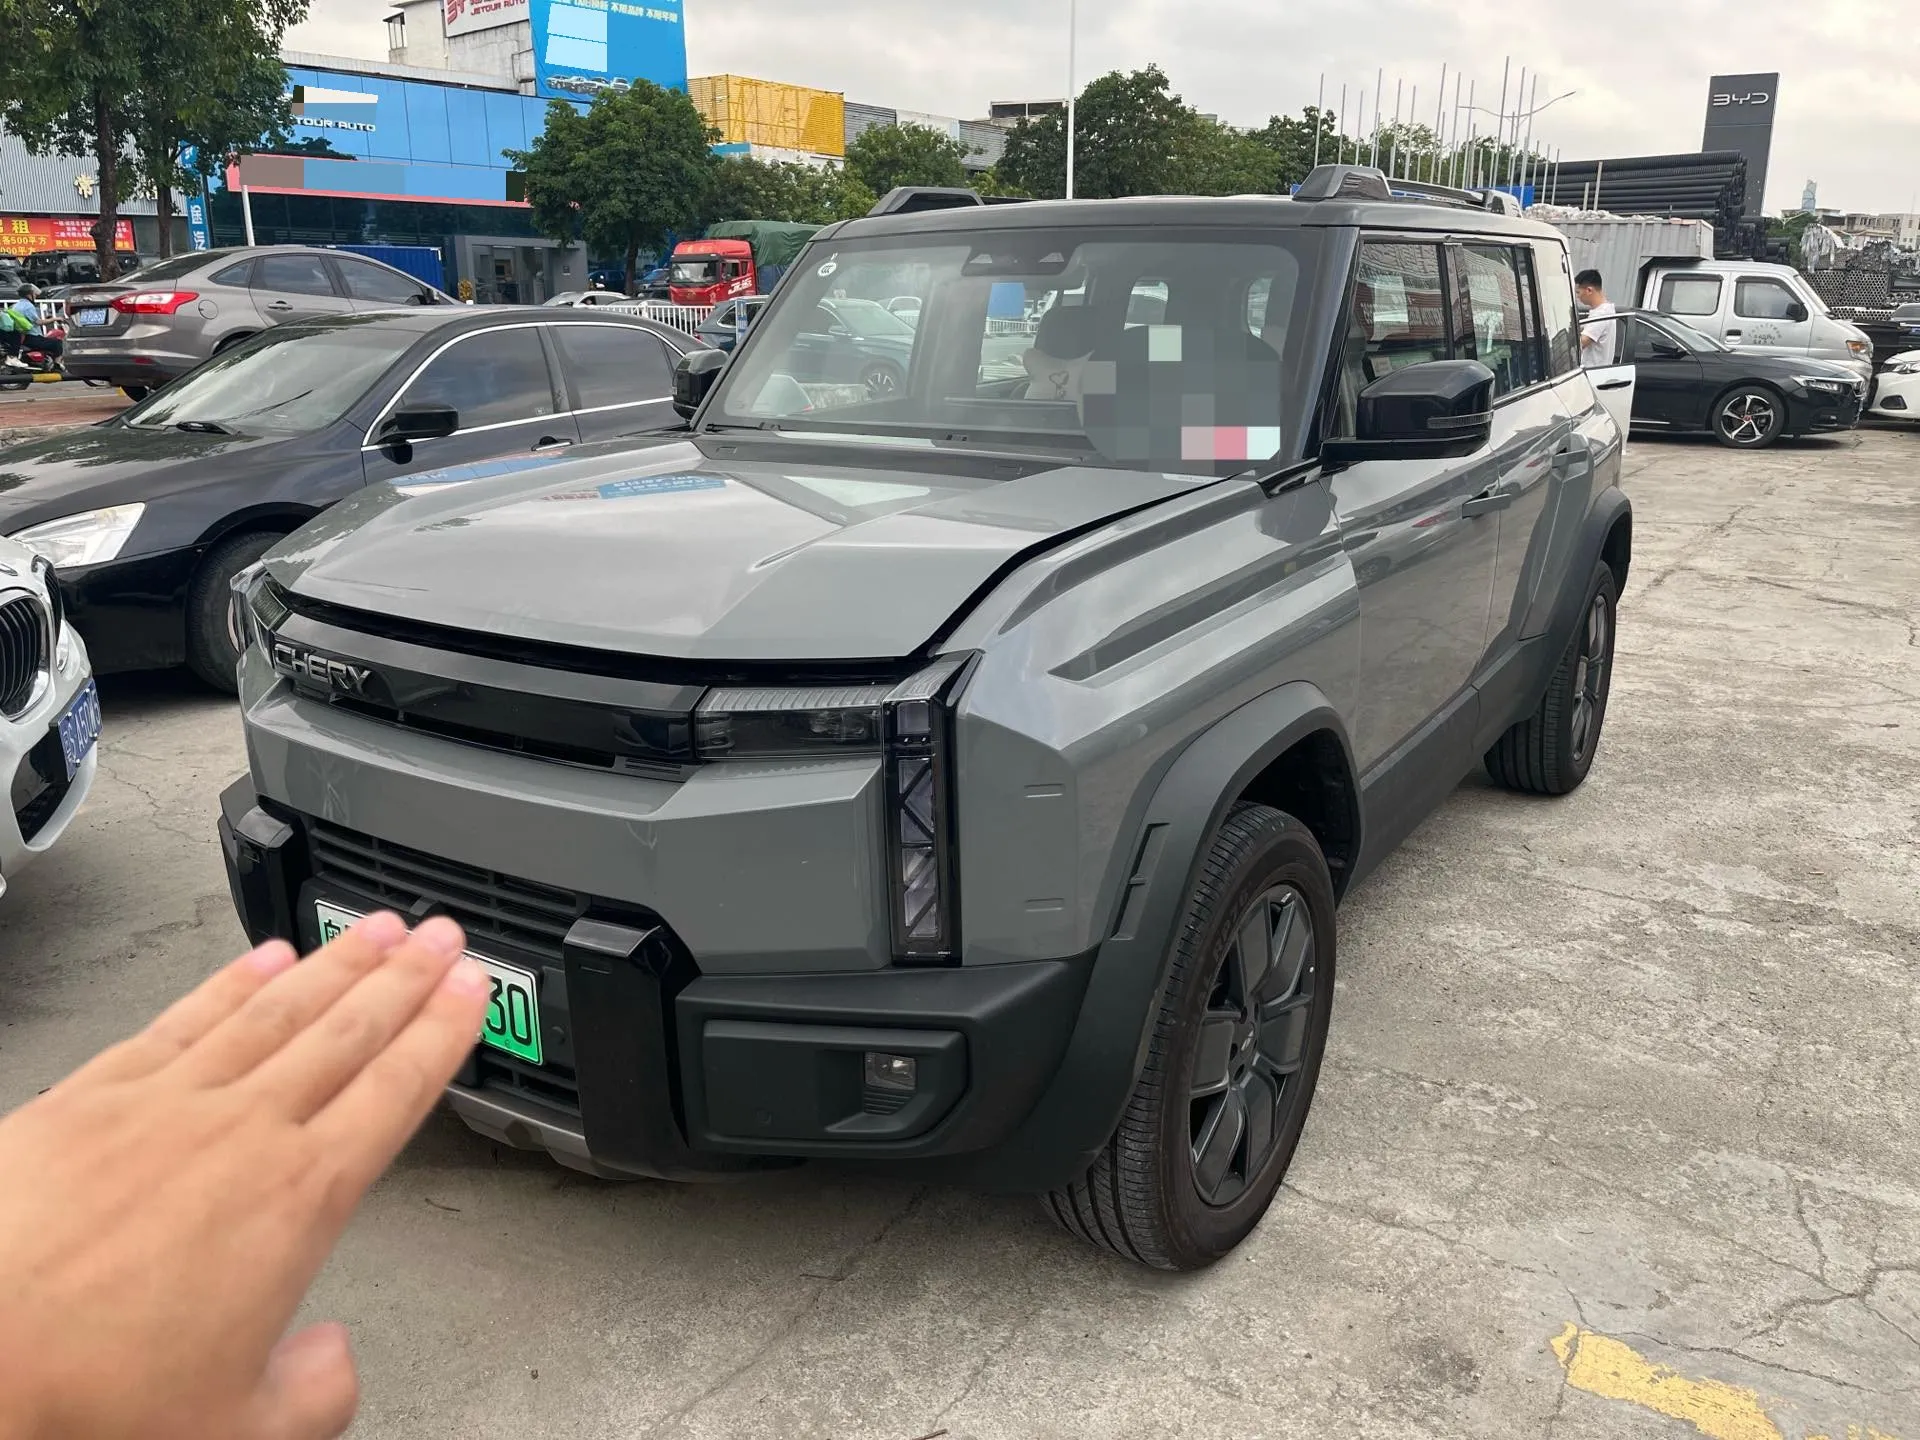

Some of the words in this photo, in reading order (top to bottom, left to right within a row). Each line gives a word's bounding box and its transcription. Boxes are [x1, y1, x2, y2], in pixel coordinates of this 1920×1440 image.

[1712, 92, 1769, 106] BYD
[338, 121, 376, 133] AUTO
[275, 643, 372, 696] CHERY
